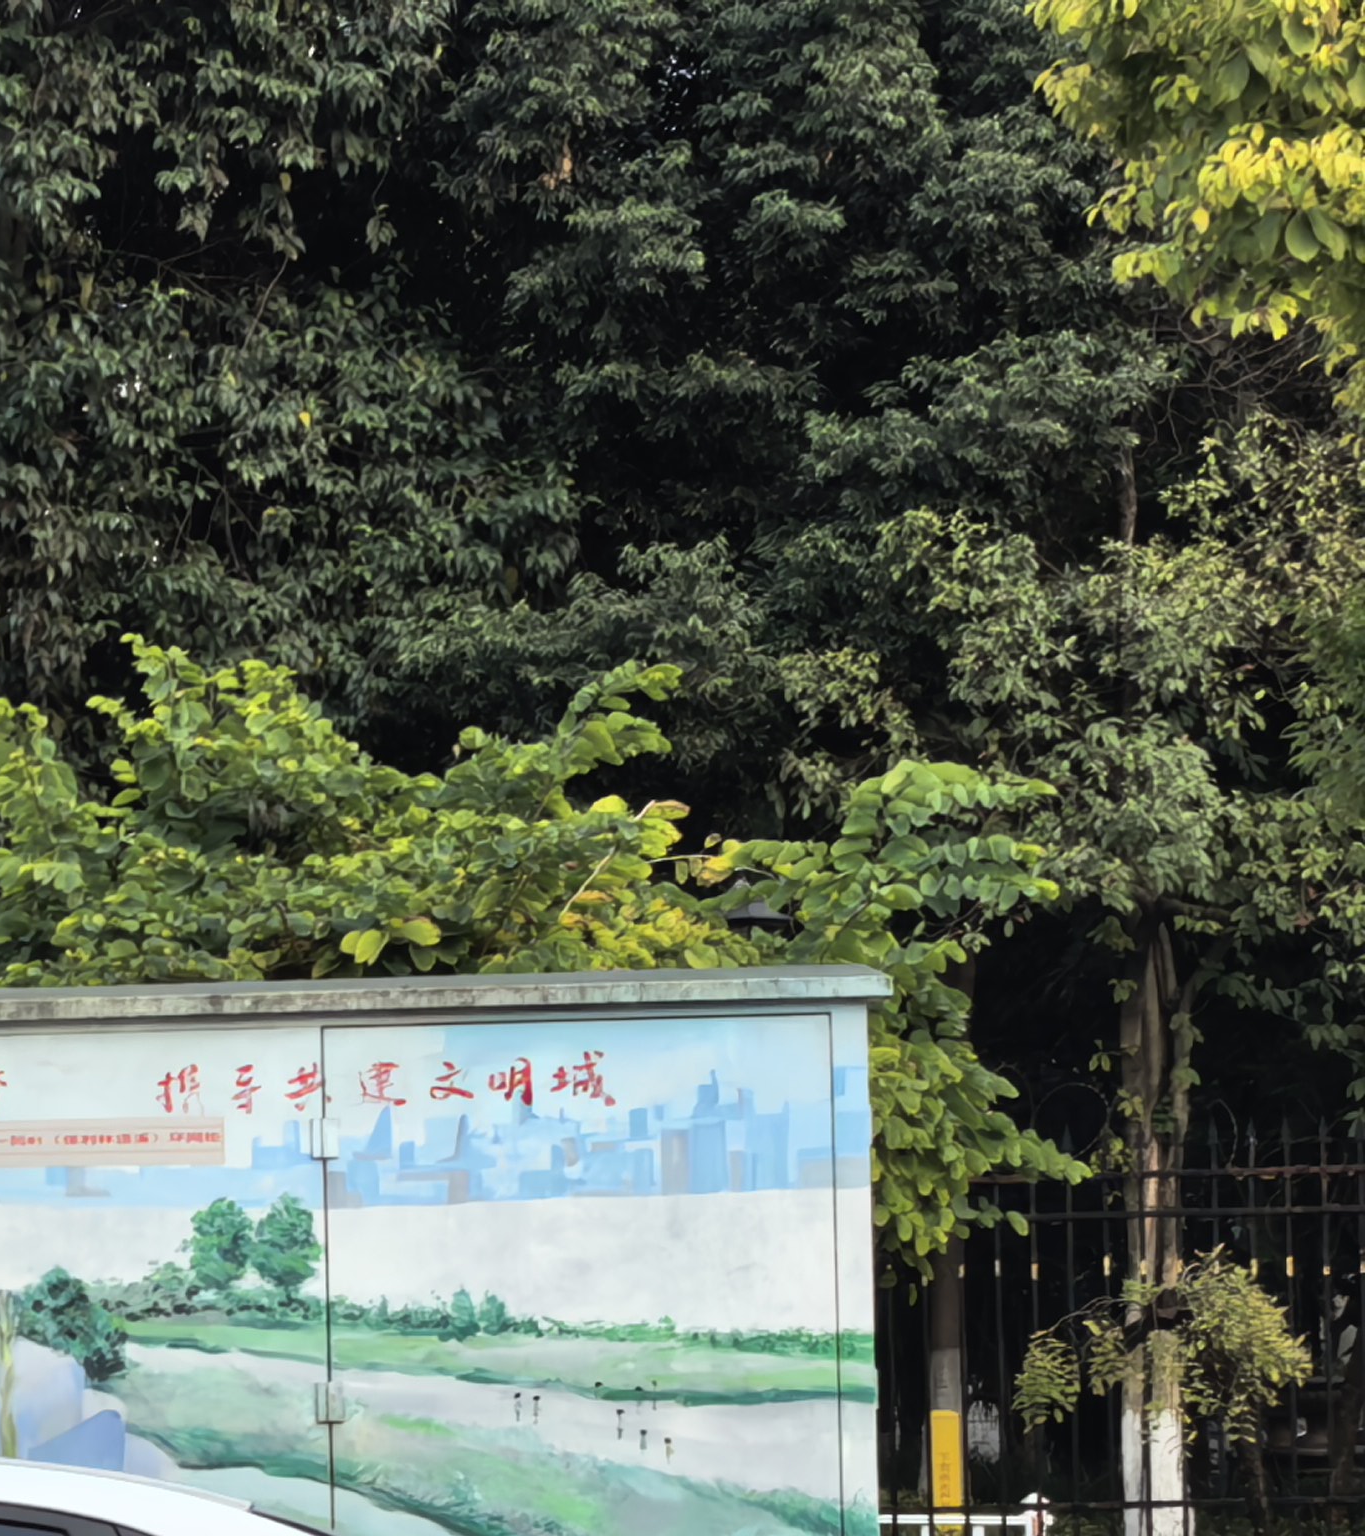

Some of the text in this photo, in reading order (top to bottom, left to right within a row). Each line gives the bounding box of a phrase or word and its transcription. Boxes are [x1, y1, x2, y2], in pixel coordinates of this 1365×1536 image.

[156, 1049, 617, 1119] 携手共建文明城
